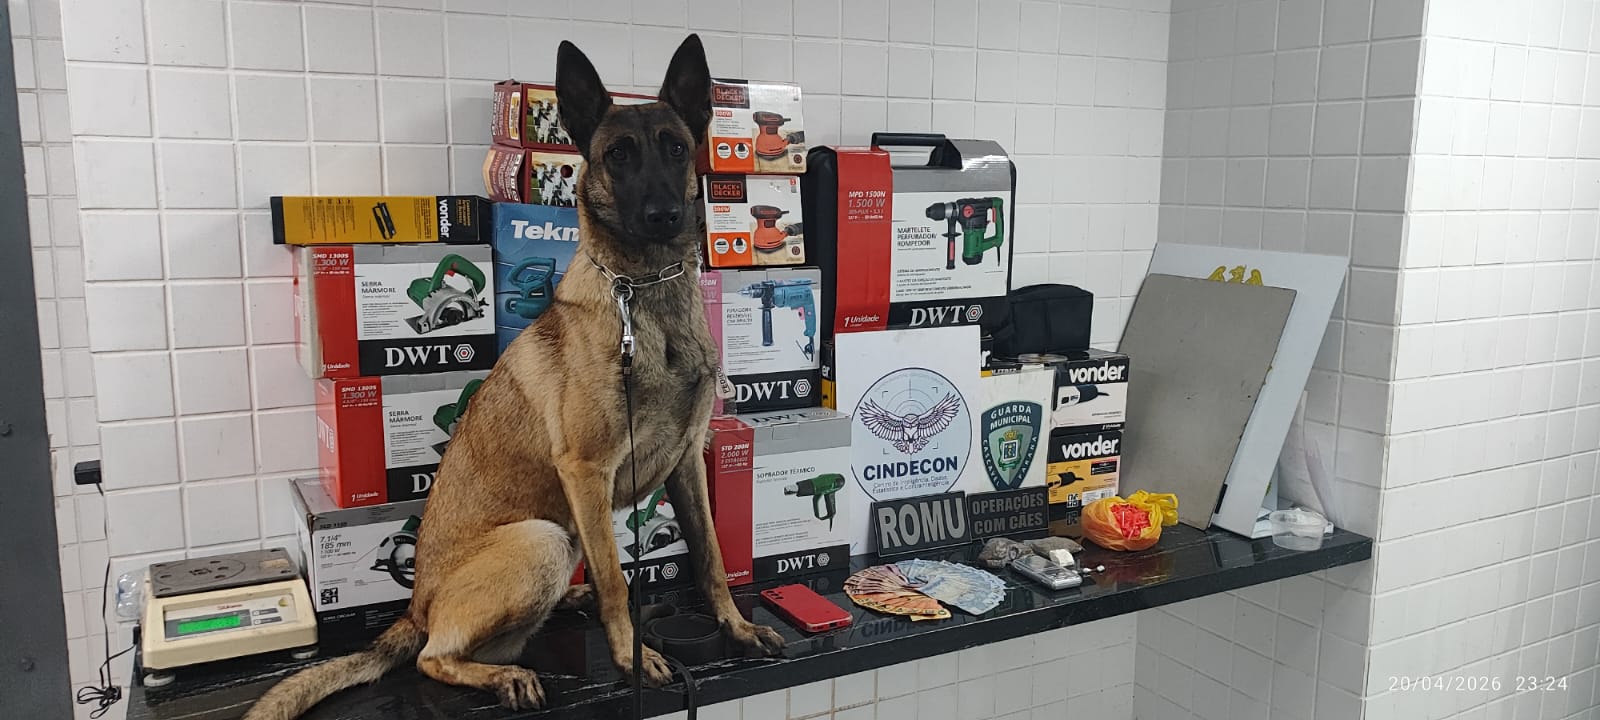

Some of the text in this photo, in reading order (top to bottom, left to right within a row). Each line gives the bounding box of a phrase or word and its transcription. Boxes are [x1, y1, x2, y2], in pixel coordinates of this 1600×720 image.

[848, 199, 885, 208] 1.500 W
[439, 199, 453, 239] vonder
[511, 220, 579, 241] Tekn
[850, 314, 880, 323] Unidade
[908, 305, 965, 327] DWT
[384, 344, 453, 368] DWT
[1069, 361, 1125, 383] vonder
[735, 380, 792, 403] DWT
[990, 404, 1032, 420] GUARDA
[990, 415, 1032, 431] MUNICIPAL
[1061, 435, 1119, 459] vonder
[863, 455, 958, 482] CINDECON
[982, 439, 1000, 486] CASCAVEL
[756, 470, 788, 479] SOPRADOR
[972, 493, 1044, 515] OPERAÇÕES
[877, 497, 966, 549] ROMU
[974, 511, 1043, 535] COM CÃES
[321, 542, 334, 550] 185
[776, 554, 816, 574] DWT
[622, 565, 660, 586] WT
